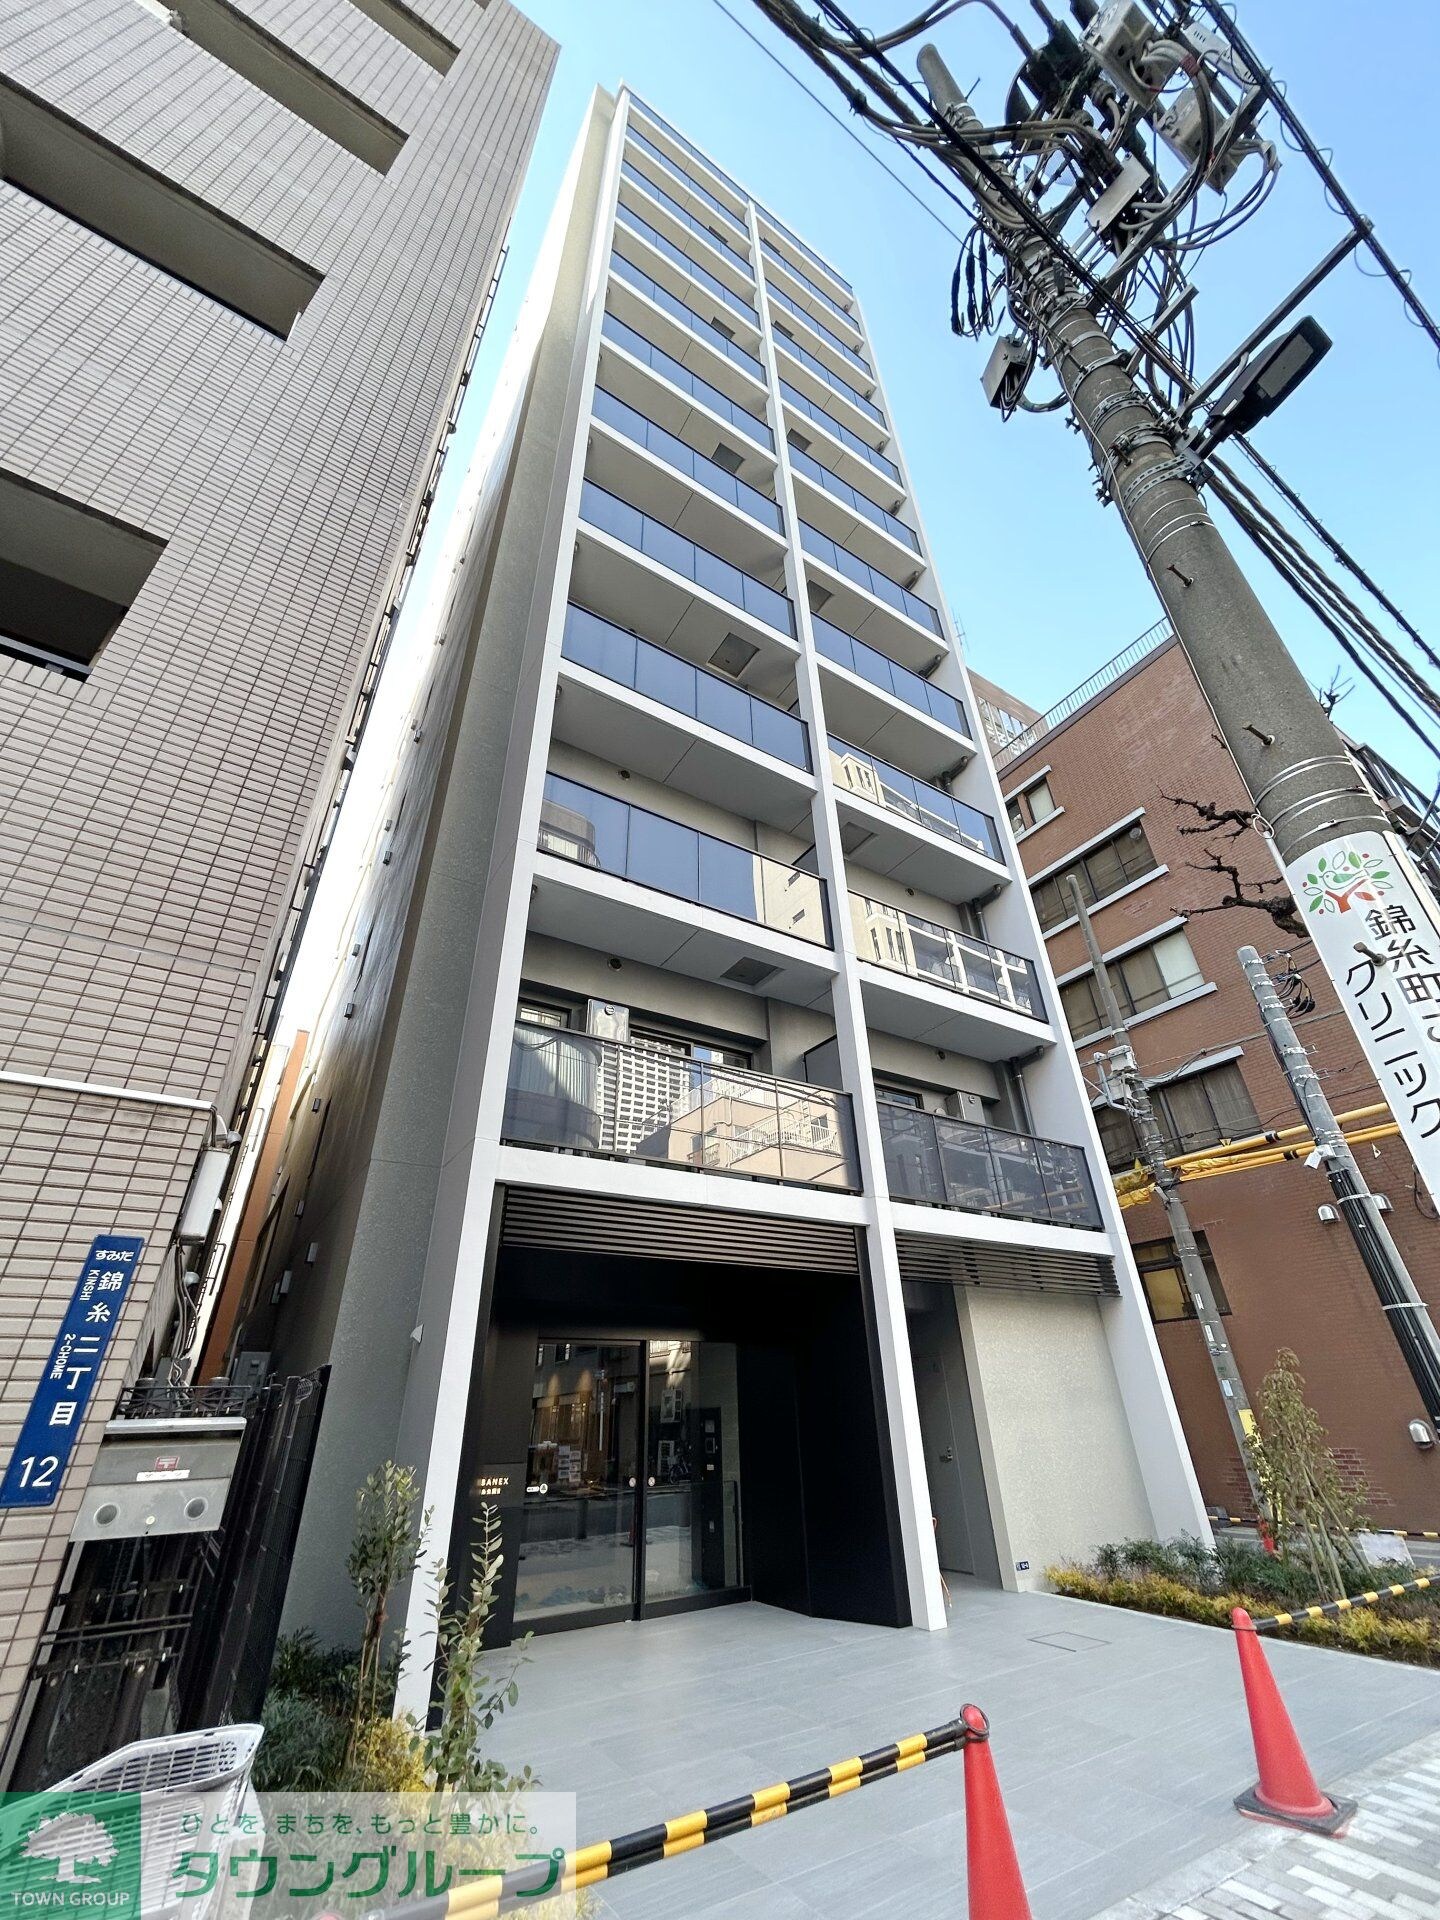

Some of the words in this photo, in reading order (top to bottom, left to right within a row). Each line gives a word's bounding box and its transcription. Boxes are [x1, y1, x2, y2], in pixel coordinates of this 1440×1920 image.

[1346, 959, 1440, 1139] クリニック
[94, 1249, 134, 1262] すみだ
[79, 1269, 101, 1301] KINSHI
[49, 1271, 125, 1426] 錦糸二丁目
[49, 1333, 77, 1380] 2-CHOME
[19, 1455, 59, 1488] 12
